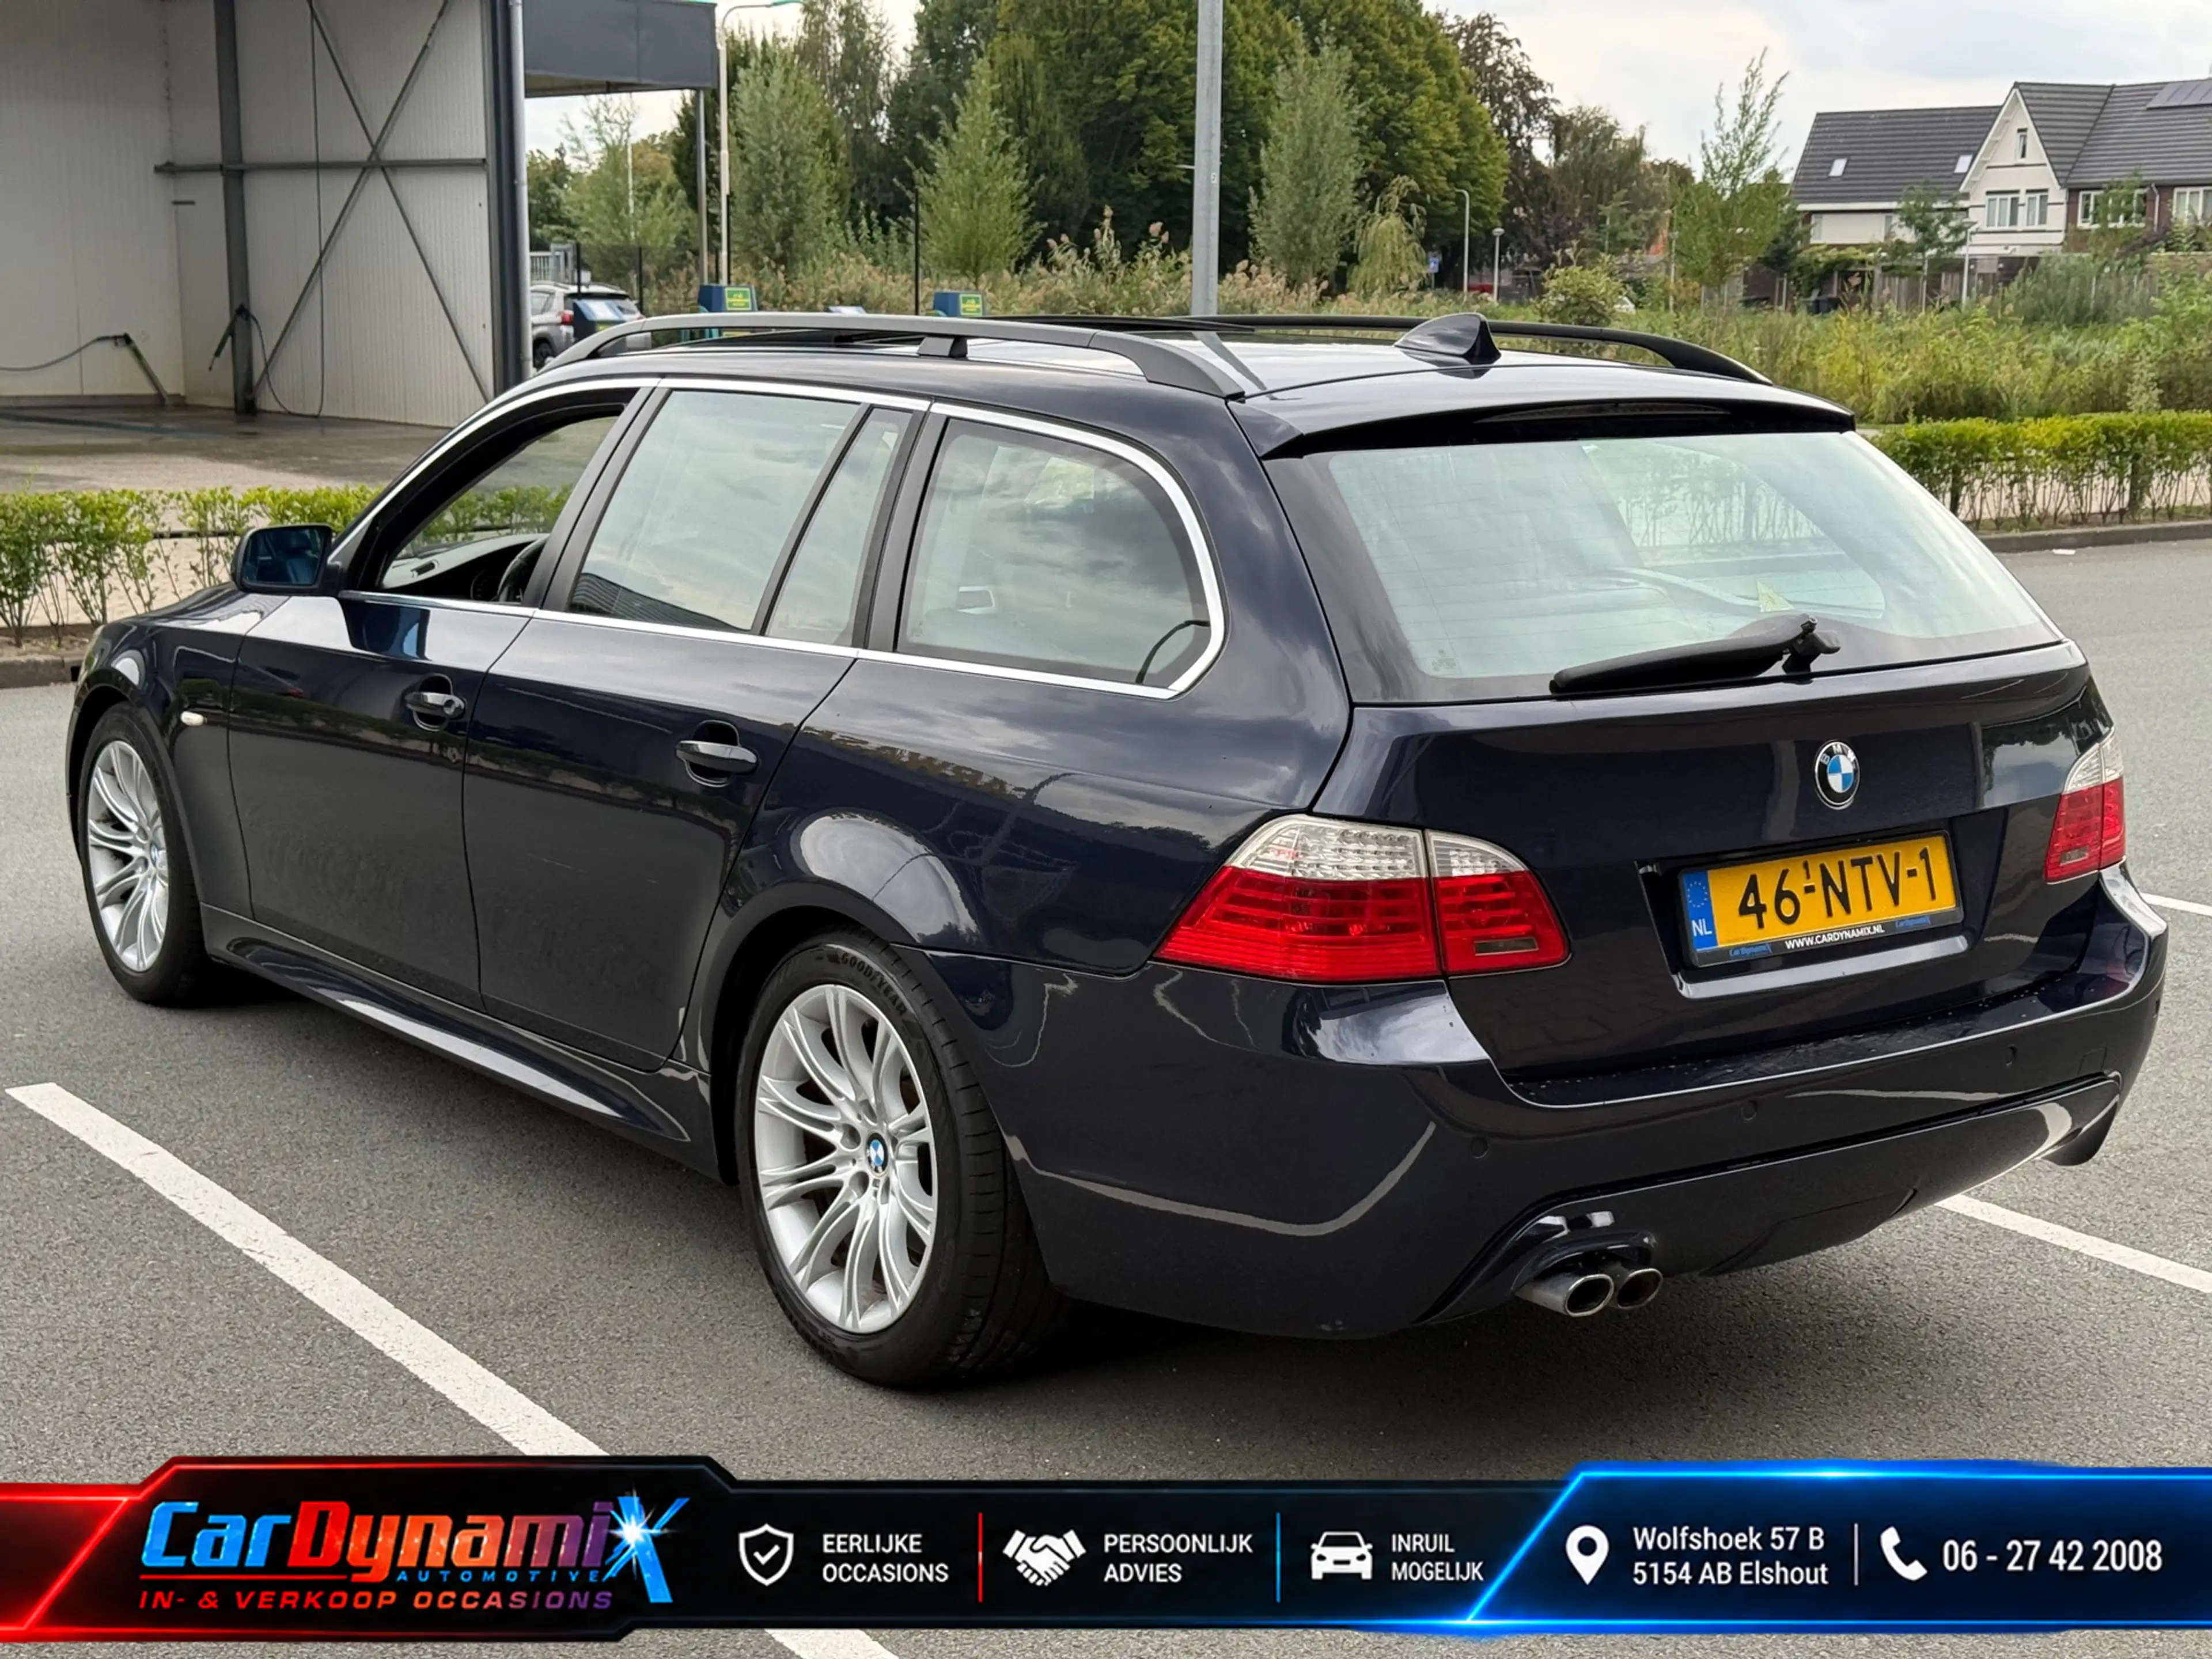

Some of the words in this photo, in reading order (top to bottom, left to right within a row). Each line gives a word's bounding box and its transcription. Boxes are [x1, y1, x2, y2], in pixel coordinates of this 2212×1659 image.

[1820, 744, 1856, 766] BMW
[1738, 846, 1937, 930] 46-NTV-1
[1692, 918, 1713, 937] NL
[1785, 924, 1885, 949] WWW.CARDYNAMIX.NL
[841, 952, 908, 1016] GOODYEAR
